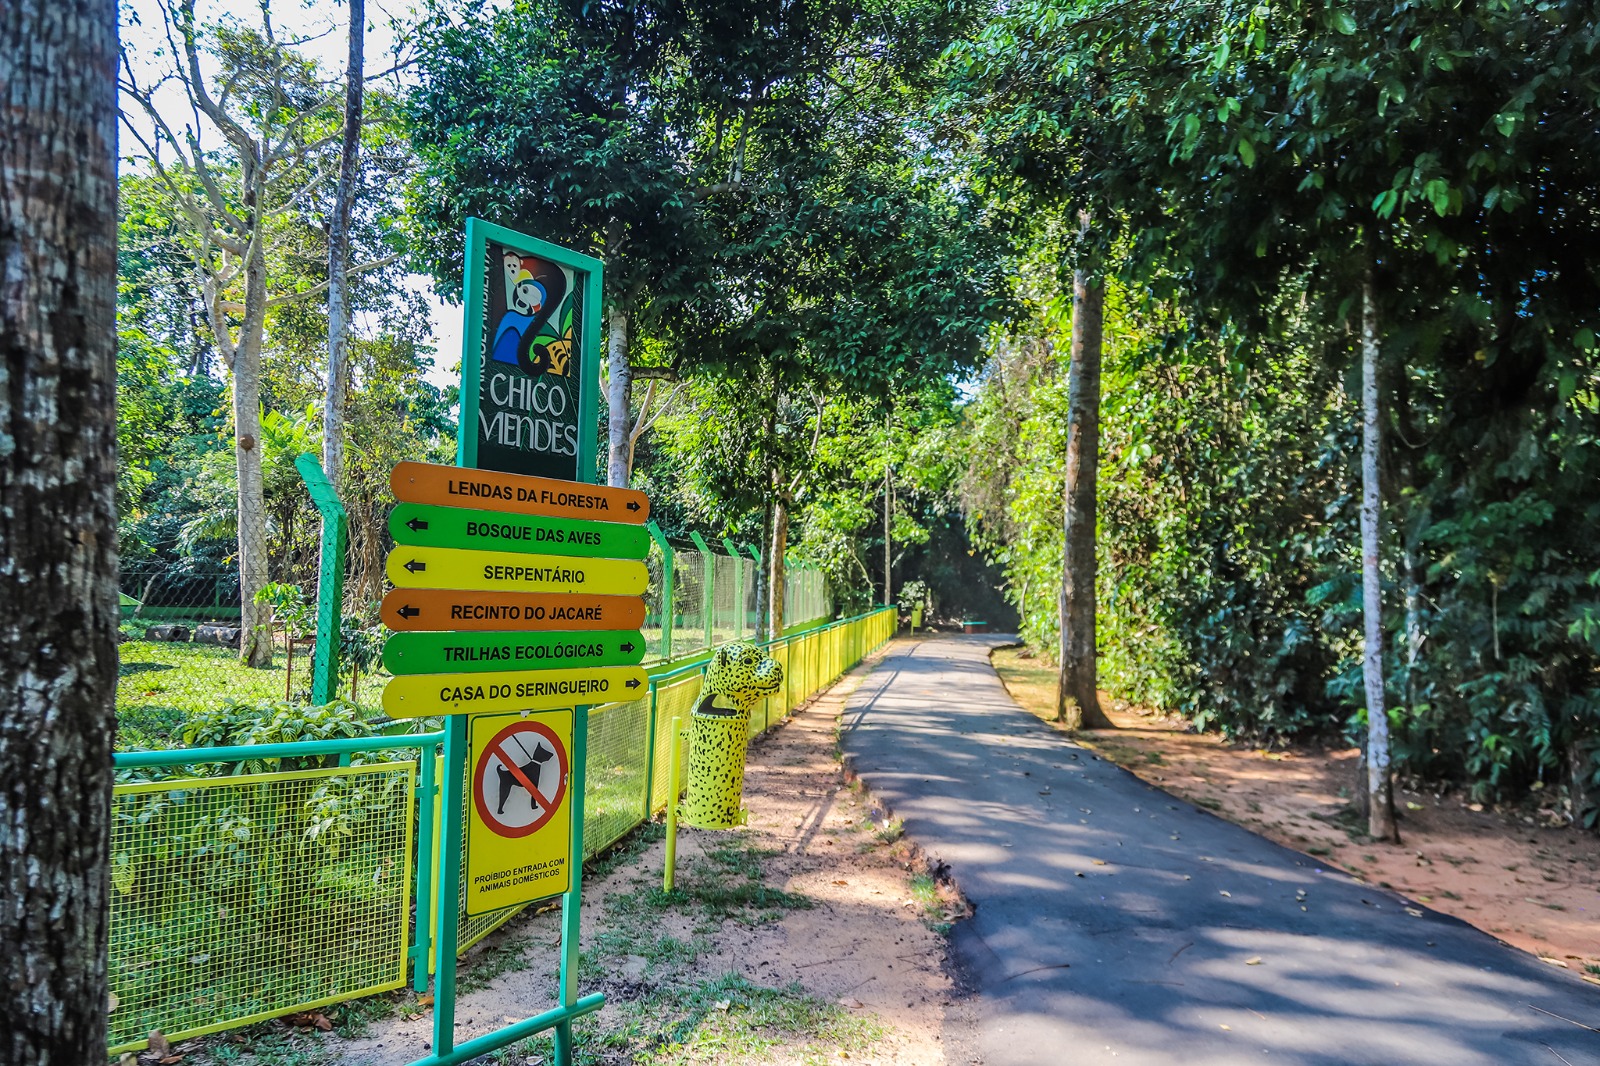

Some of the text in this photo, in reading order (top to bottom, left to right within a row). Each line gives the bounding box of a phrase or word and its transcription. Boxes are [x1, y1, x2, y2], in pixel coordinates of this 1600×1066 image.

[490, 373, 566, 416] CHICO
[448, 480, 609, 510] LENDAS DA FLORESTA
[467, 522, 601, 545] BOSQUE DAS AVES
[483, 565, 585, 583] SERPENTÁRIO
[451, 605, 602, 620] RECINTO DO JACARÉ
[444, 642, 603, 661] TRILHAS ECOLÓGICAS
[440, 679, 609, 701] CASA DO SERINGUEIRO
[513, 861, 548, 876] ENTRADA
[548, 858, 565, 868] COM
[479, 868, 560, 893] ANIMAIS DOMÉSTICOS
